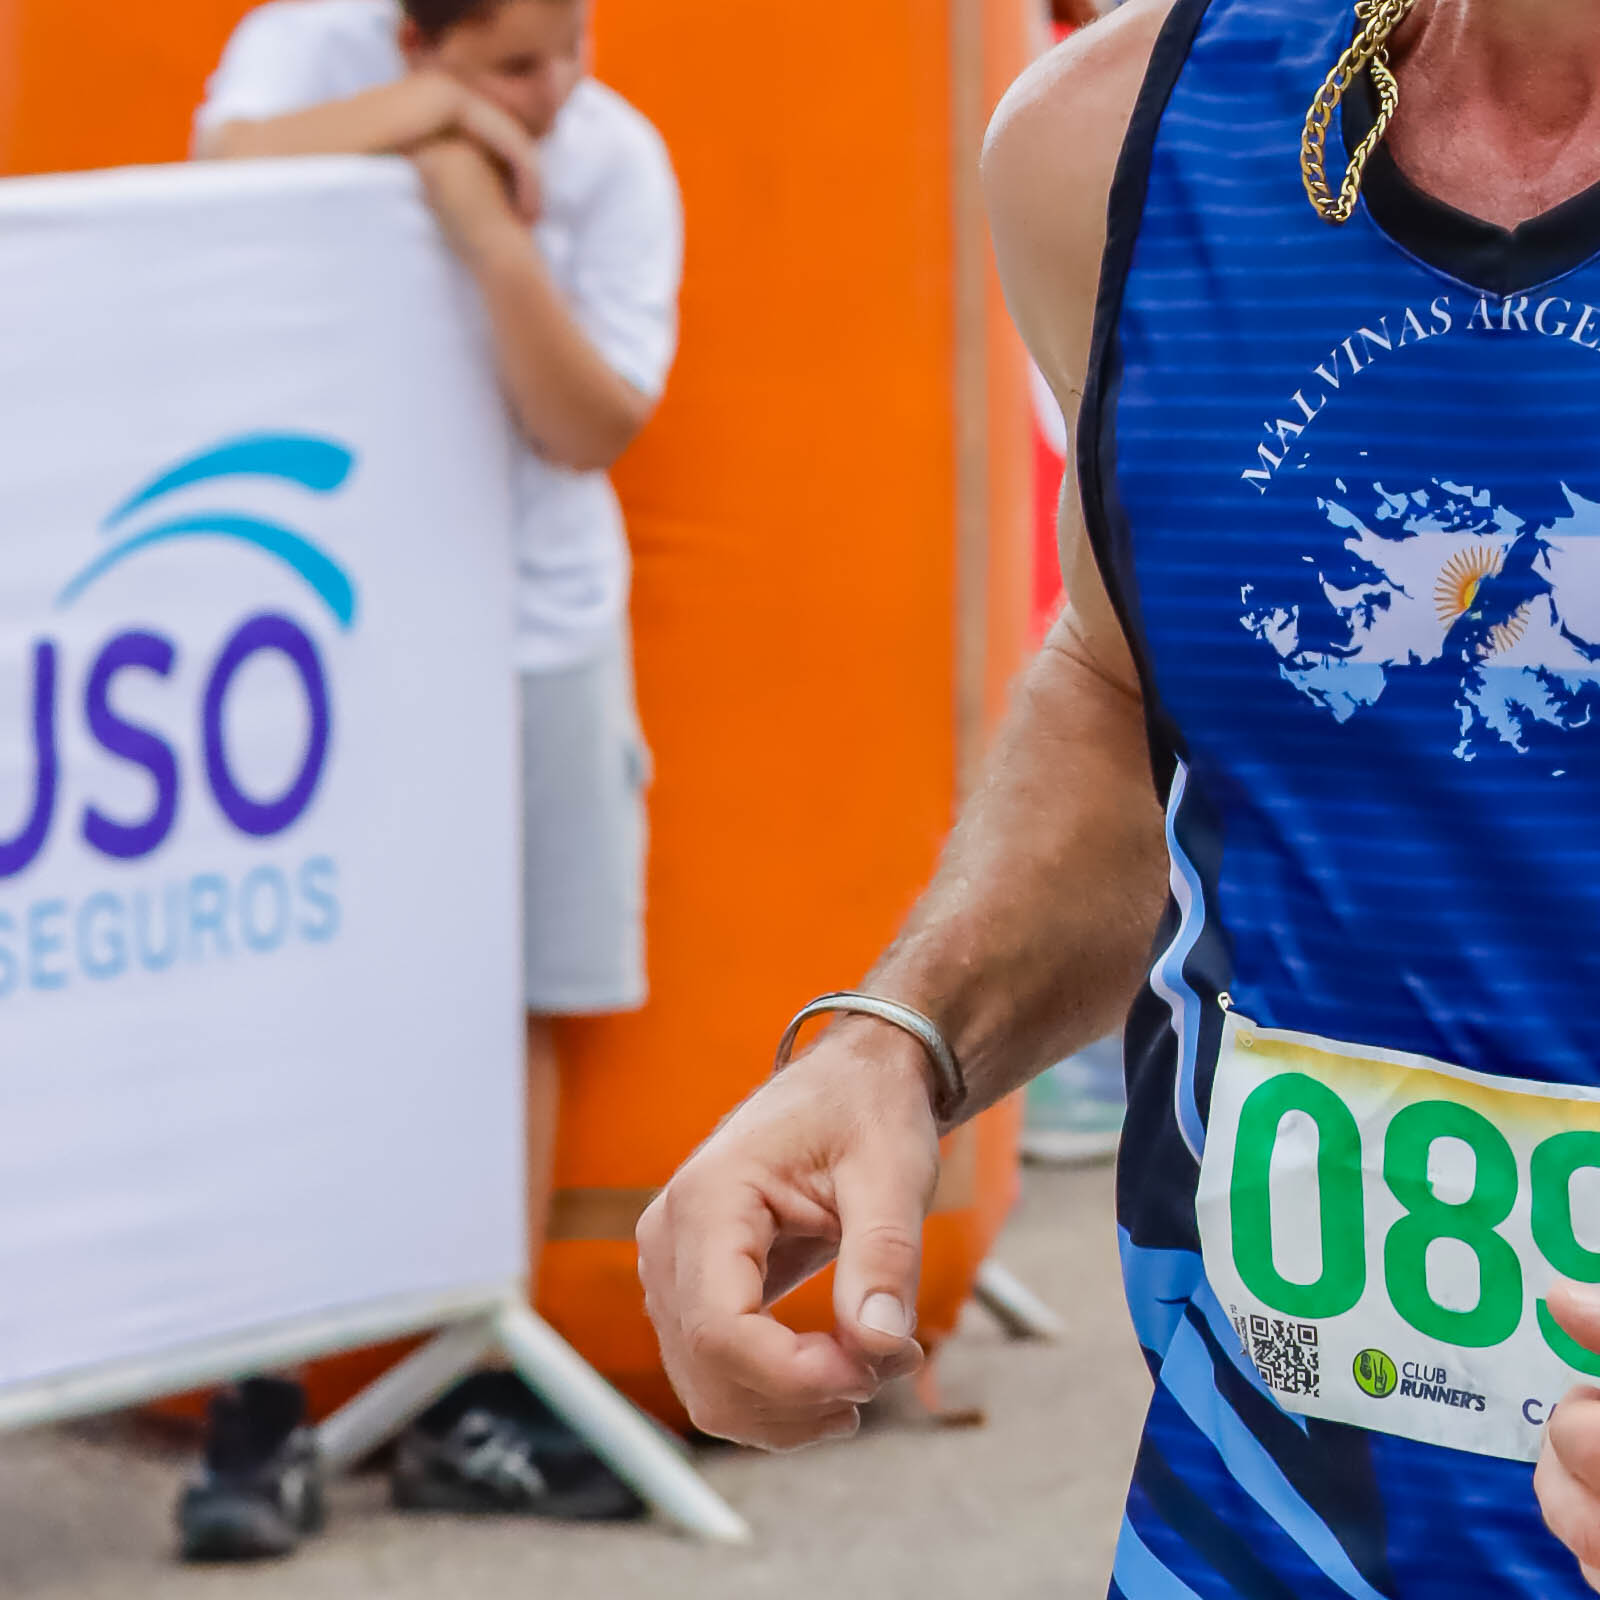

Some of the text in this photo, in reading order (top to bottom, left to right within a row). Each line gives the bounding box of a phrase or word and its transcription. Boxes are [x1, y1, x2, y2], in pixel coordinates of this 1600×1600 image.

[1241, 296, 1453, 494] MALVINAS
[1402, 1361, 1447, 1385] CLUB
[1400, 1378, 1487, 1413] RUNNER'S
